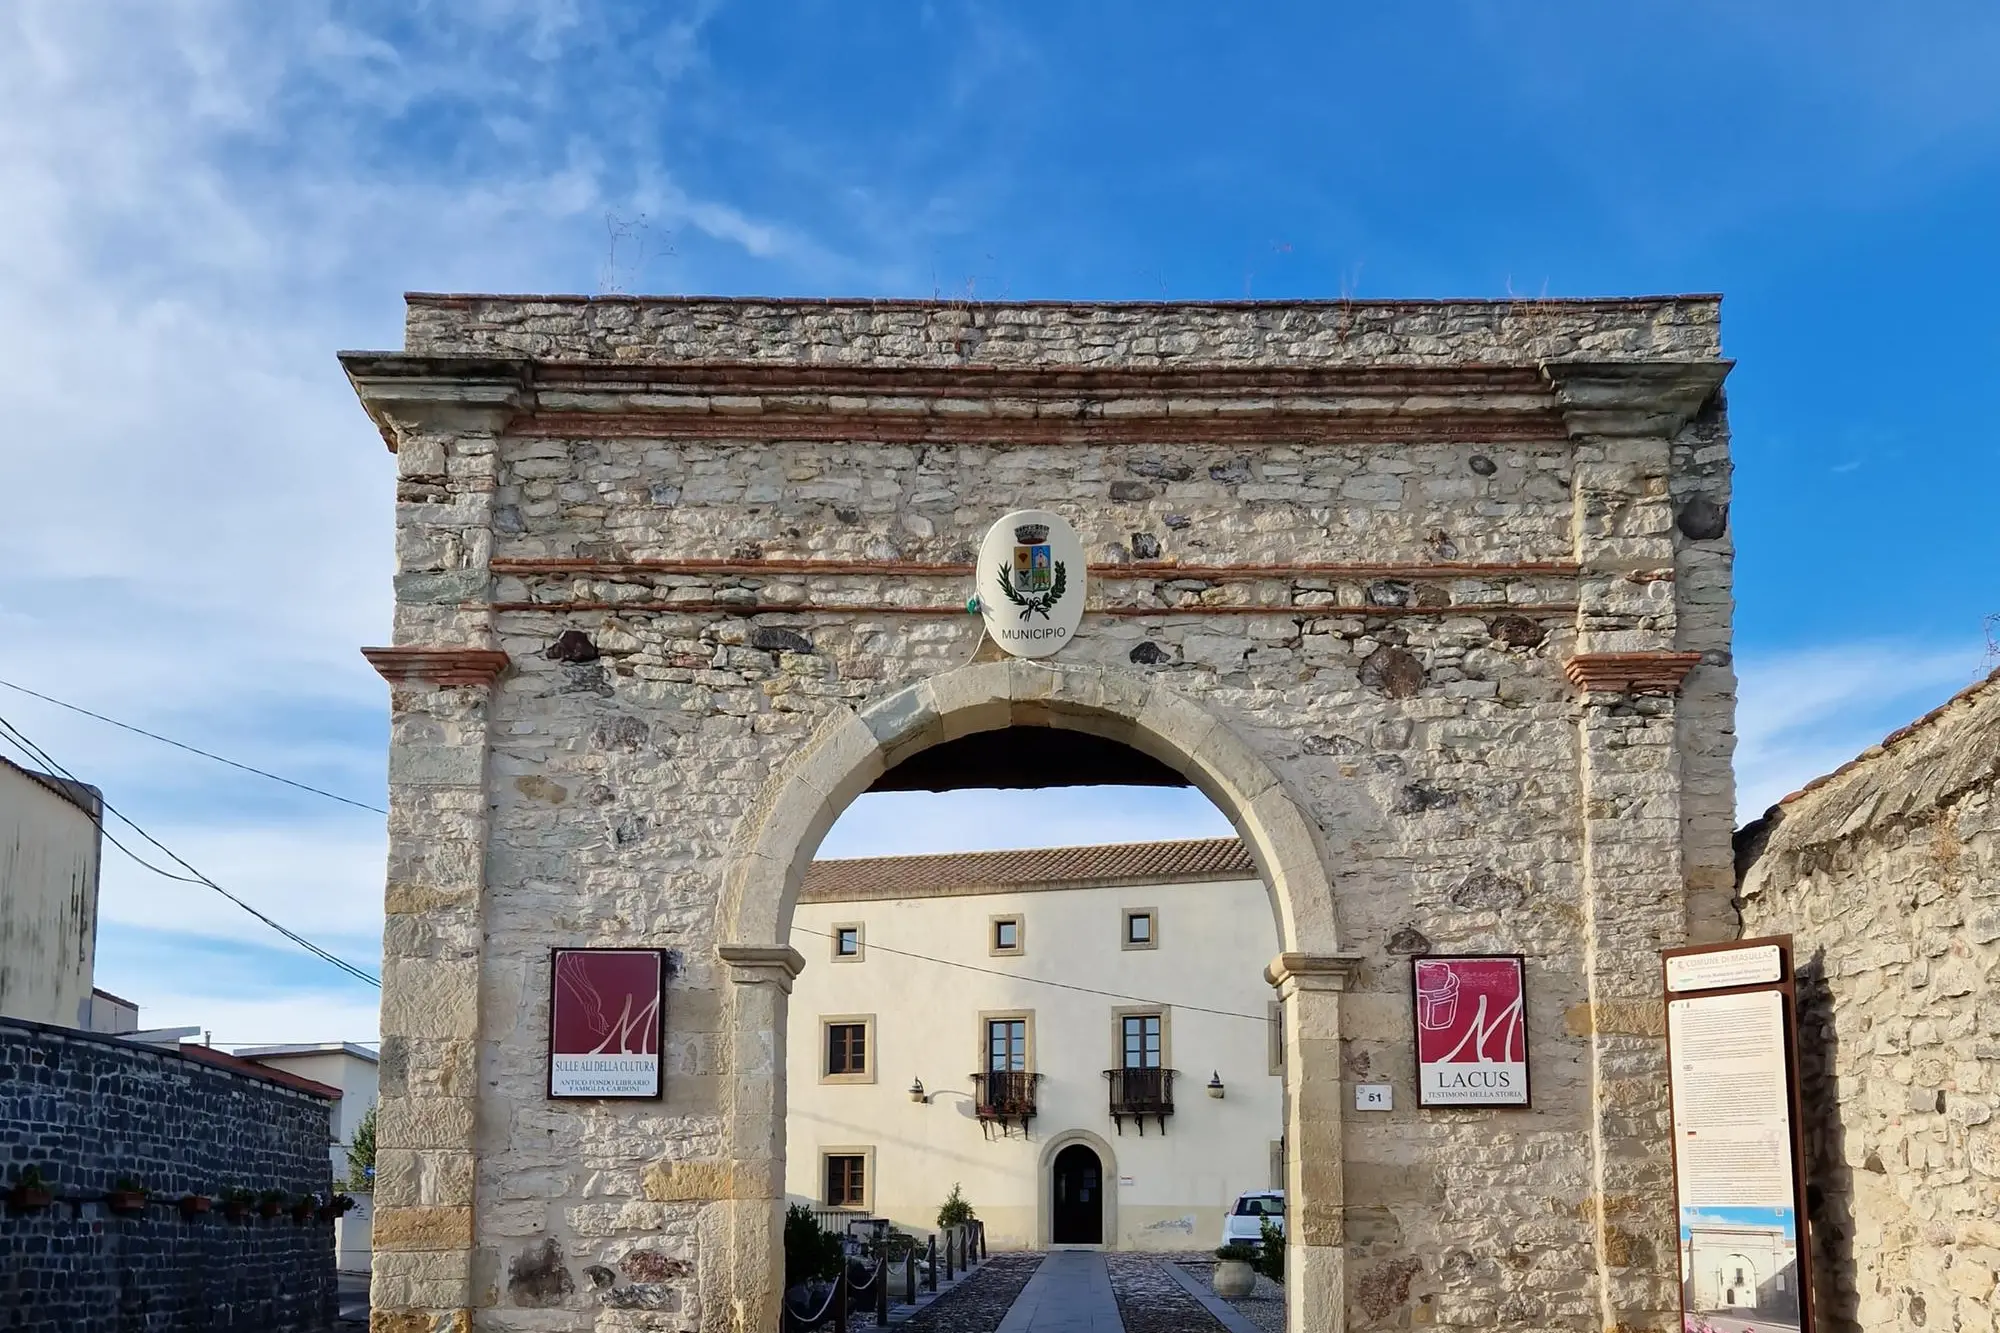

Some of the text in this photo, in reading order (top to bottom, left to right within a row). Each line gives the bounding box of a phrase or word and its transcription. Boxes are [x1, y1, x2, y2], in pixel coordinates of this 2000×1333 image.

[1002, 627, 1066, 640] MUNICIPIO
[1686, 956, 1719, 968] COMUNE
[555, 1060, 655, 1072] SULLE ALI DELLA CULTURA
[1438, 1071, 1510, 1088] LACUS
[1368, 1092, 1382, 1103] 51
